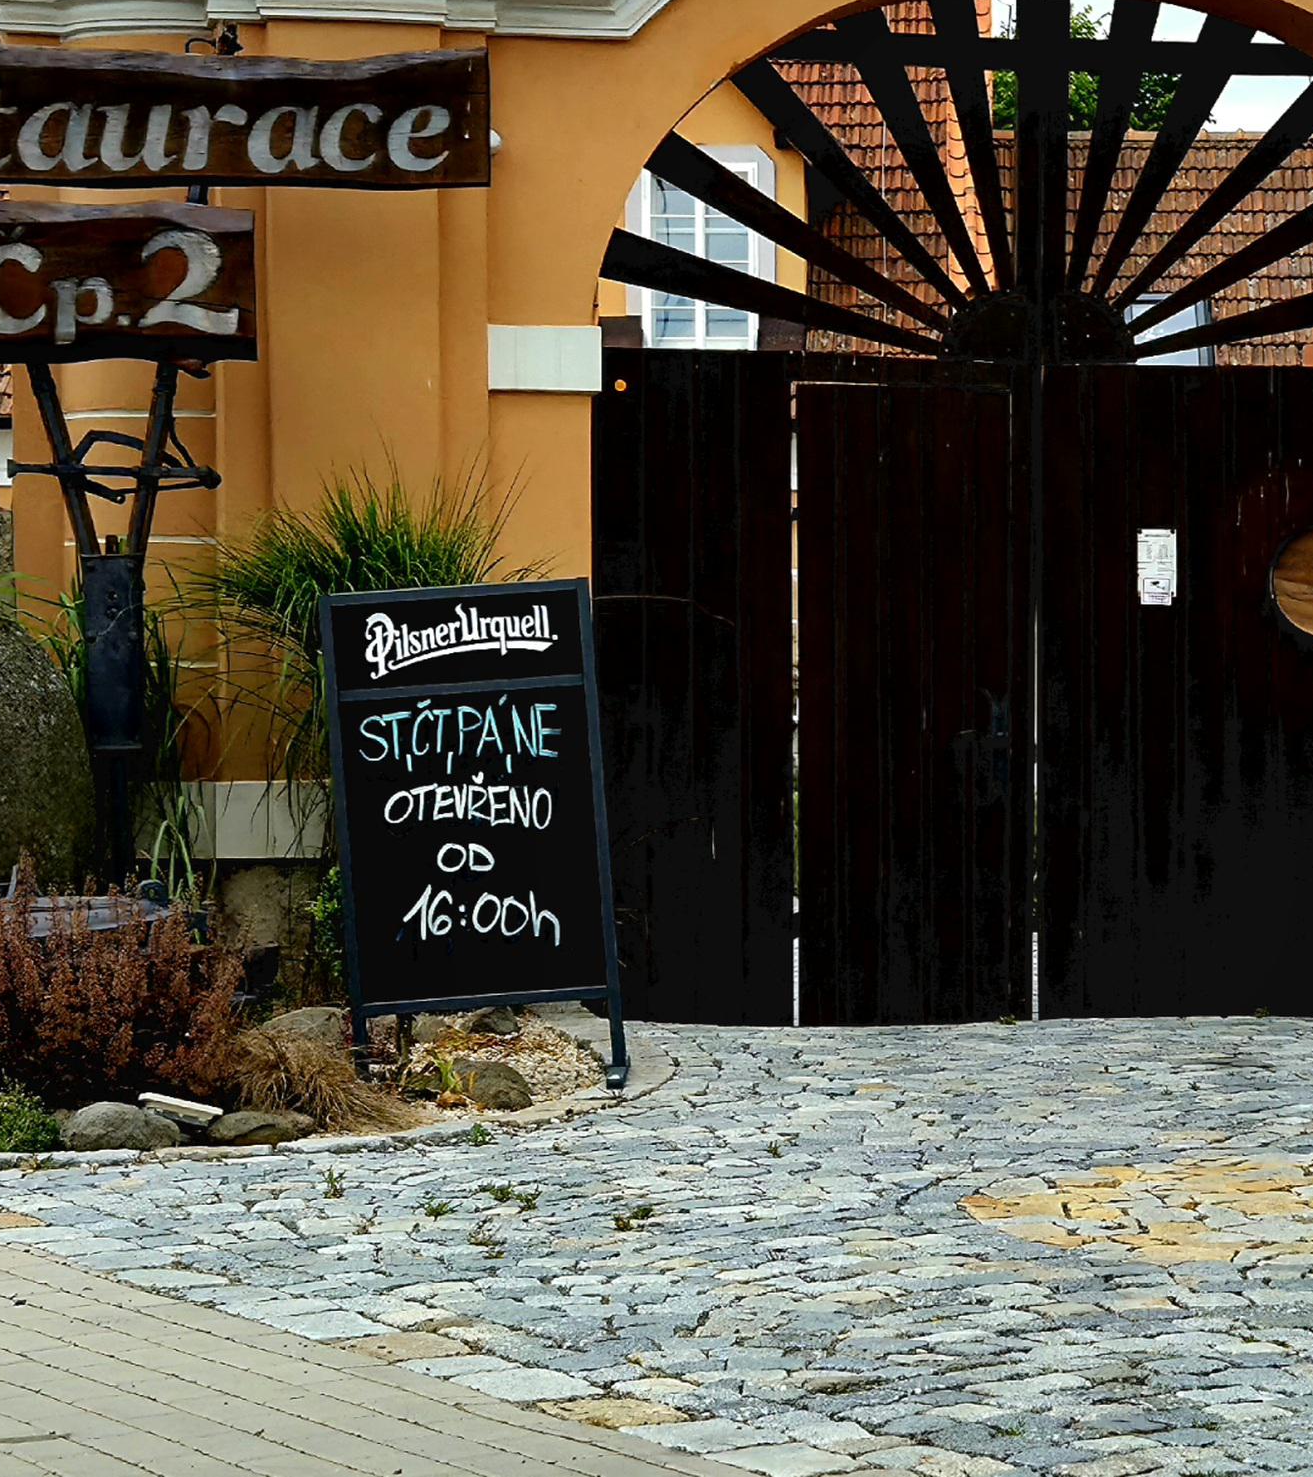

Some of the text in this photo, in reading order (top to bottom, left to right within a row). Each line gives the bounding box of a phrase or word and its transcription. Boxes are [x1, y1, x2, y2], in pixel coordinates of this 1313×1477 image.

[364, 612, 462, 680] Pilsner
[383, 770, 553, 830] OTEVŘENO
[436, 842, 496, 873] OD
